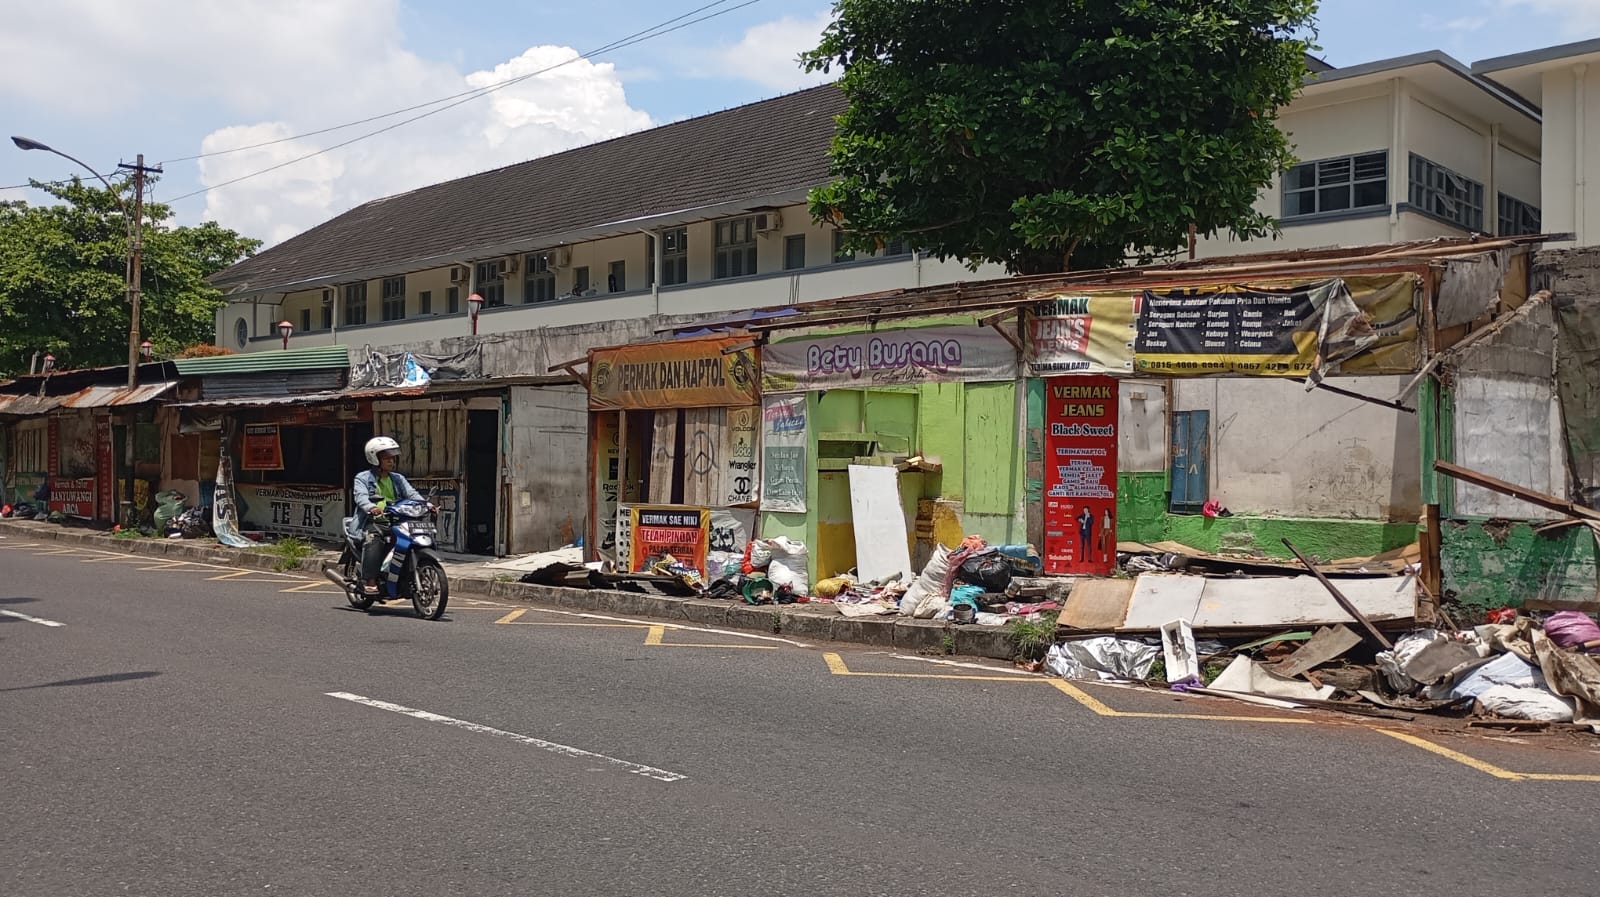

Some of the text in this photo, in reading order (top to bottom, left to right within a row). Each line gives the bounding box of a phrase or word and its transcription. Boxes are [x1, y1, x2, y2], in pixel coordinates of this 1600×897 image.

[1032, 298, 1089, 316] VERMAK
[1209, 297, 1235, 306] Pakaian
[1237, 297, 1251, 305] Pria
[1268, 296, 1291, 304] Wanita
[1036, 319, 1085, 340] JEAN'S
[1241, 330, 1273, 338] Wearpack
[807, 338, 961, 379] Bety Busana
[1071, 361, 1090, 369] BARU
[618, 357, 726, 392] PERMAK DAN NAPTOL
[1053, 386, 1112, 399] VERMAK
[1060, 404, 1105, 417] JEANS
[1051, 423, 1113, 436] Black Sweet
[729, 460, 757, 471] Wrangler
[51, 490, 92, 502] BANYUWANGI
[641, 515, 698, 526] VERMAK SAE NIKI
[641, 529, 698, 544] TELAH PINDAH
